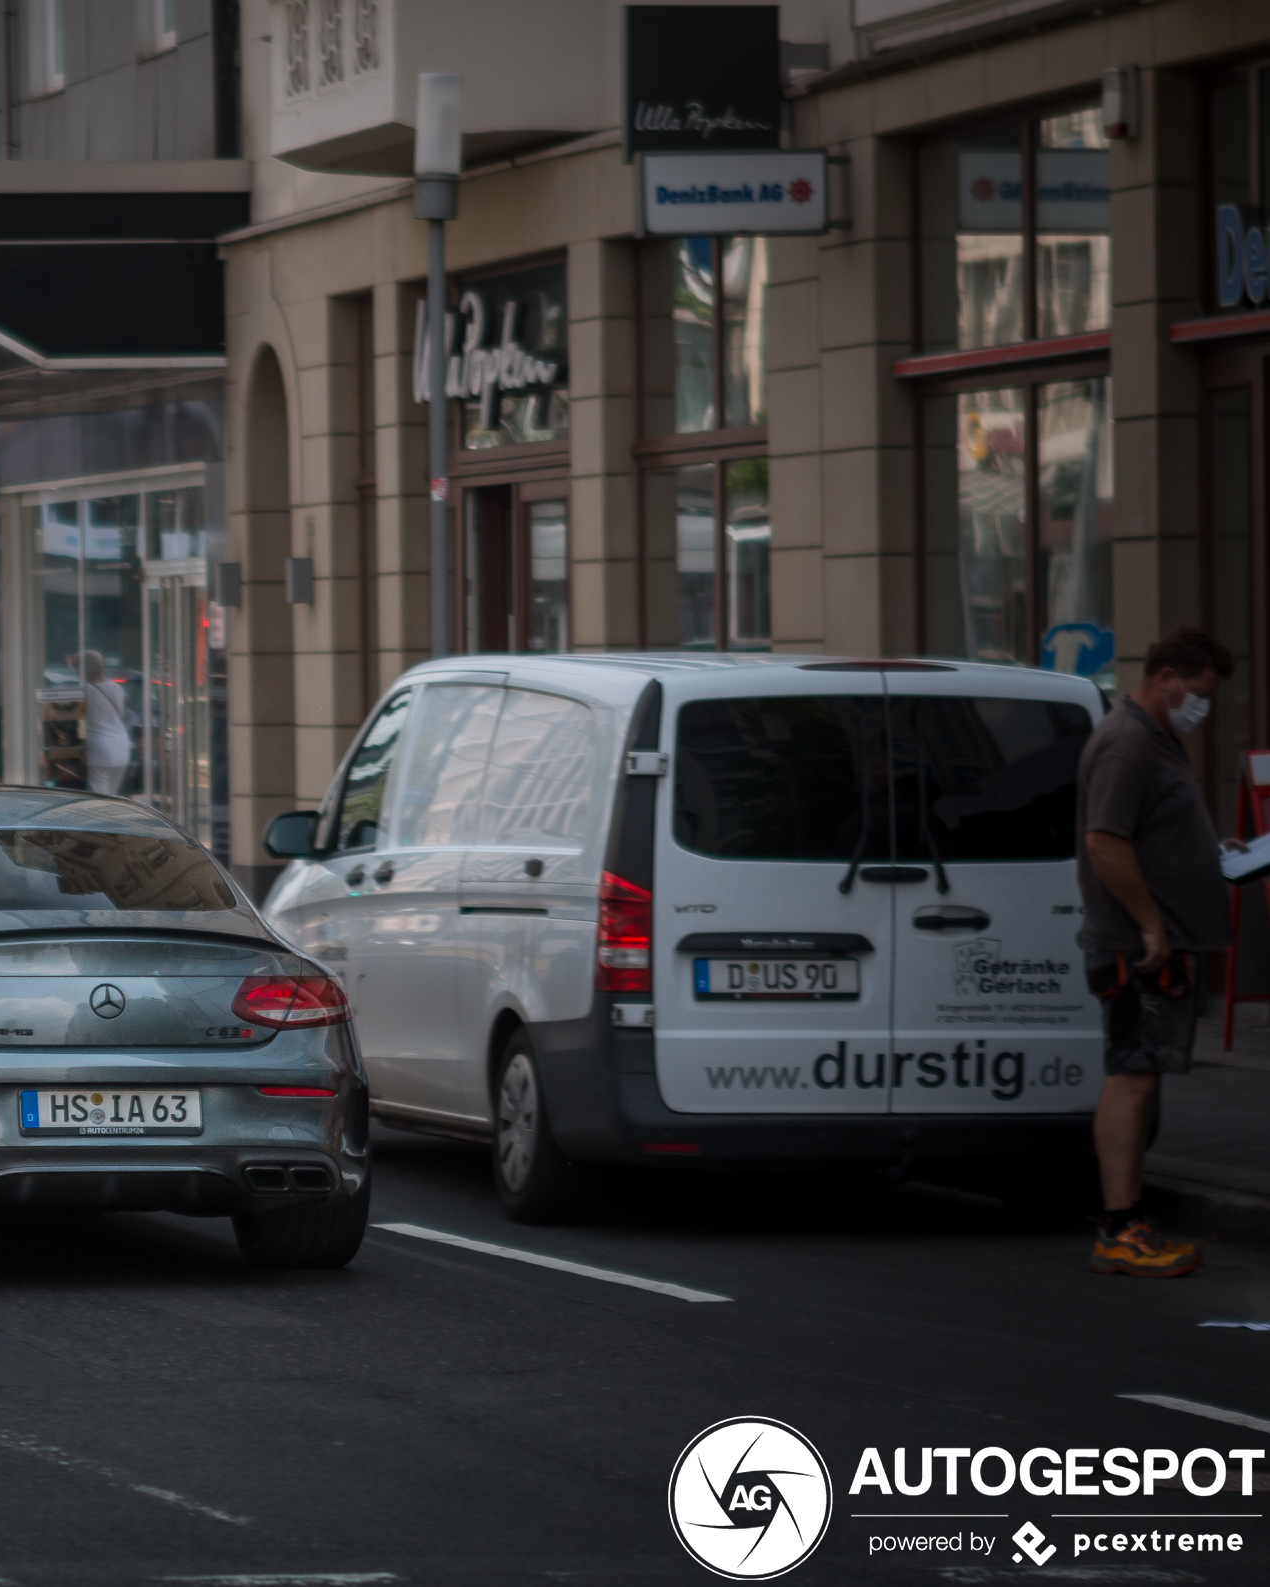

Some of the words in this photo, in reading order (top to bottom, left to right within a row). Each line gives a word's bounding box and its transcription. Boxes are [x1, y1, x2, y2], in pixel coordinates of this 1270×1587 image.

[634, 102, 682, 131] Ulla
[684, 102, 773, 140] Popken
[655, 184, 754, 204] DenizBank
[758, 184, 783, 203] AG
[1217, 204, 1270, 307] De
[673, 904, 717, 914] VITO
[727, 963, 745, 990] D
[805, 963, 838, 990] 90
[974, 958, 1070, 974] Getränke
[980, 977, 1062, 994] Gerlach
[705, 1040, 1084, 1100] www.durstig.de
[27, 1113, 34, 1122] D
[50, 1094, 89, 1123] HS
[109, 1094, 145, 1123] IA
[151, 1094, 187, 1123] 63
